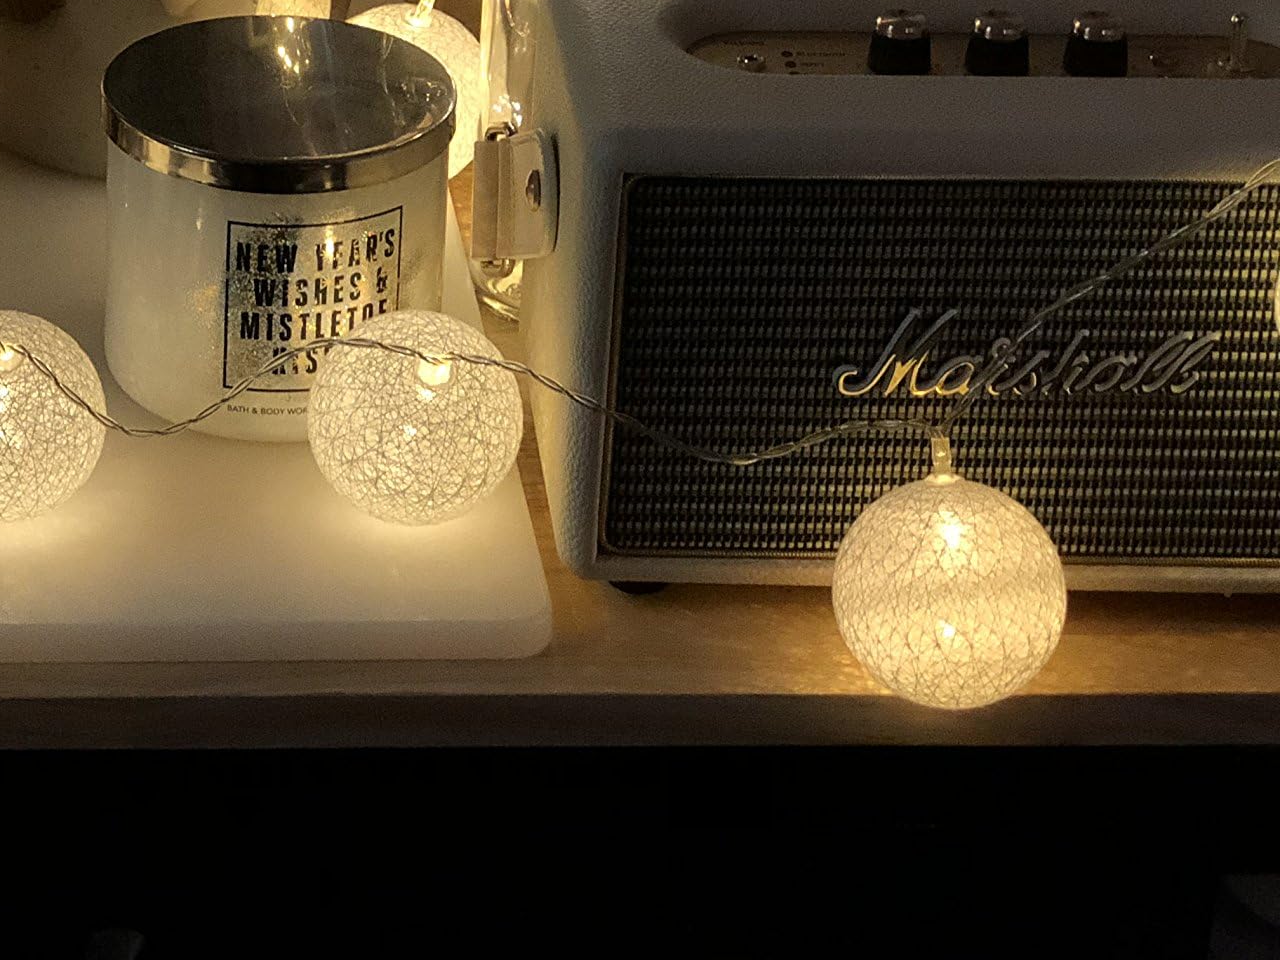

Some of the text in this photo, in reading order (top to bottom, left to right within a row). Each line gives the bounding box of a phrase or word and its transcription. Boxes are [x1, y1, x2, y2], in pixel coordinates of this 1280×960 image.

[235, 241, 299, 274] NEW
[252, 270, 363, 308] WISHES
[831, 307, 1222, 397] Marshall
[227, 404, 250, 414] BATH
[260, 407, 286, 415] BODY
